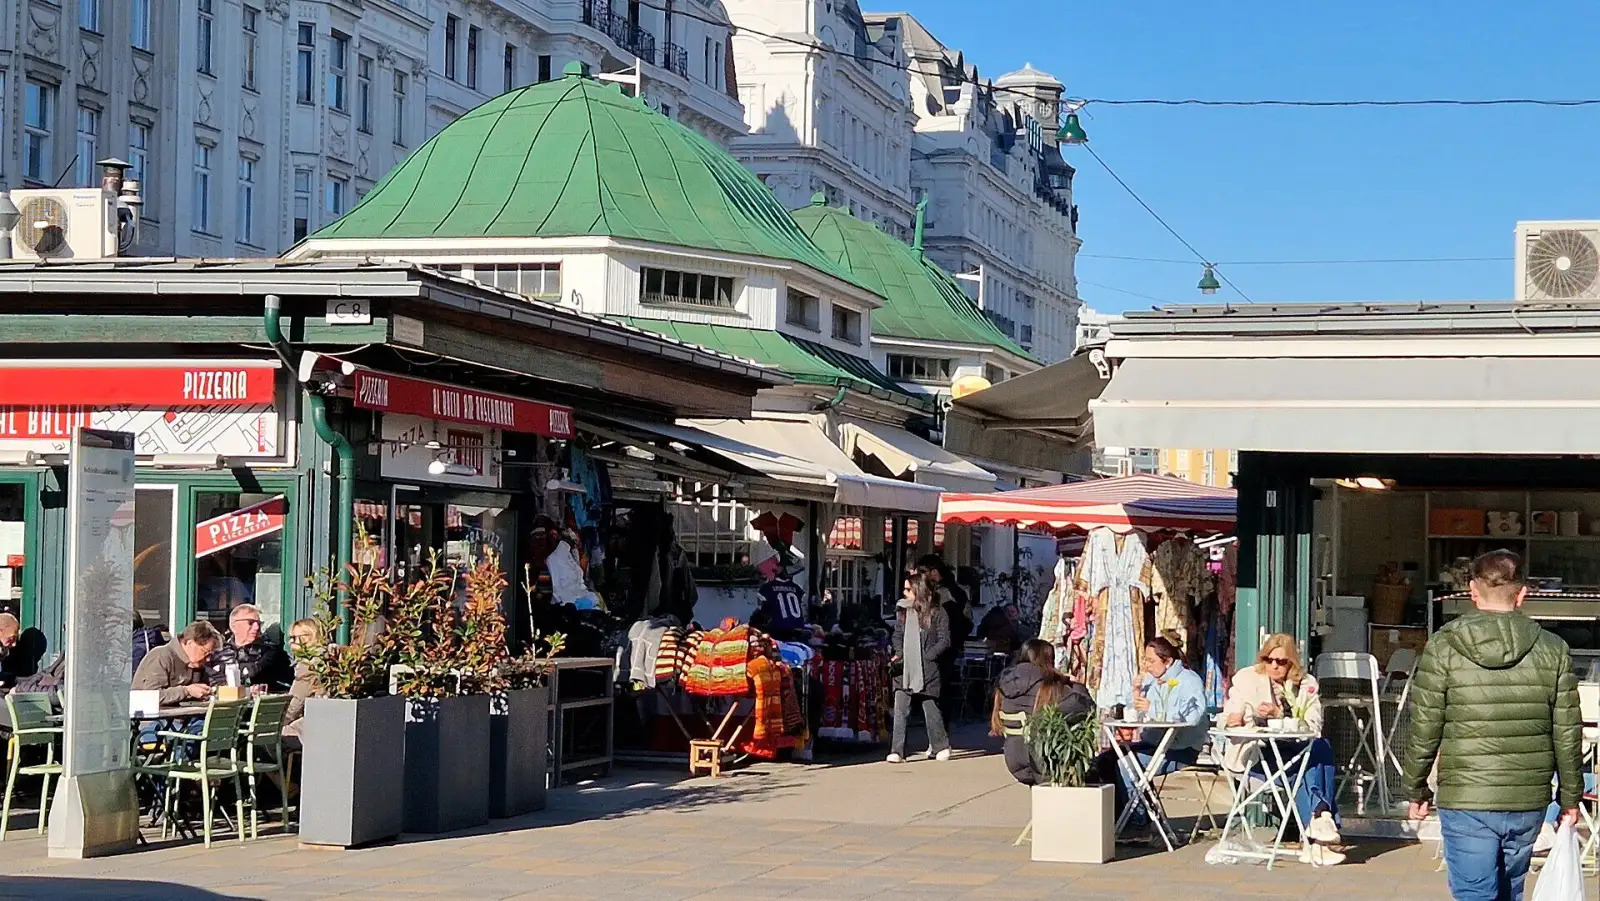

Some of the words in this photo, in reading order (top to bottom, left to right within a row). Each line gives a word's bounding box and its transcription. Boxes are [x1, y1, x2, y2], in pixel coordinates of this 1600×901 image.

[183, 370, 248, 400] PIZZERIA
[360, 375, 388, 407] PIZZERIA
[209, 509, 269, 539] PIZZA
[777, 592, 801, 619] 10
